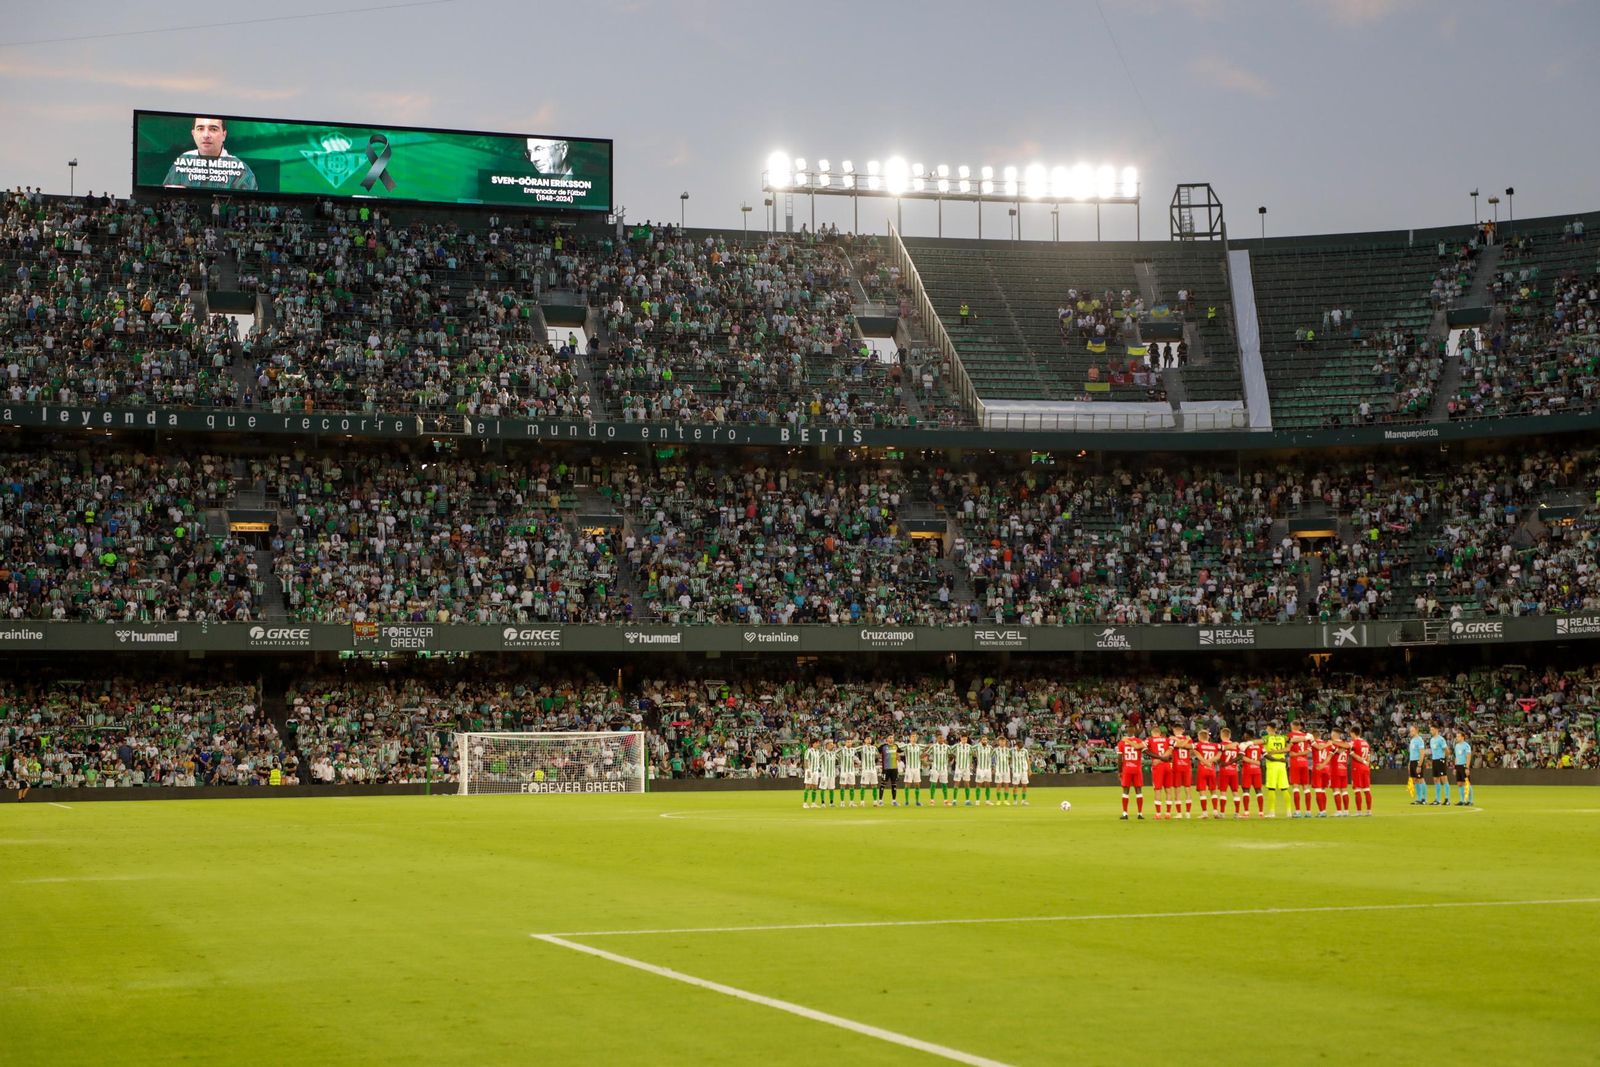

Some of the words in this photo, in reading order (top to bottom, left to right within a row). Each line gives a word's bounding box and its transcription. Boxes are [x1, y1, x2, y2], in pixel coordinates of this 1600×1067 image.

[174, 158, 207, 167] JAVIER
[208, 158, 245, 169] MÉRIDA
[175, 166, 208, 174] Periodista
[209, 168, 241, 176] Deportivo
[491, 176, 549, 187] SVEN-GÖRAN
[550, 179, 592, 189] ERIKSSON
[523, 187, 557, 195] Entrenador
[567, 189, 586, 197] Fútbol
[42, 407, 178, 425] leyenda
[206, 414, 256, 429] que
[284, 416, 403, 432] recorre
[477, 420, 500, 434] el
[527, 423, 616, 438] mundo
[781, 427, 862, 442] BETIS
[1384, 428, 1439, 439] Manquepierda
[1569, 616, 1600, 626] REALE
[382, 626, 434, 638] FOREVER
[1465, 622, 1503, 633] GREE
[1569, 625, 1600, 634] SEGUROS
[131, 630, 178, 642] hummel
[266, 628, 310, 639] GREE
[519, 629, 561, 640] GREE
[639, 632, 681, 643] hummel
[757, 632, 799, 642] trainline
[861, 629, 914, 642] Cruzcampo
[974, 630, 1027, 640] REVEL
[1215, 629, 1255, 638] REALE
[390, 638, 425, 648] GREEN
[1124, 746, 1138, 761] 55
[1157, 743, 1165, 757] 5
[521, 782, 581, 793] FOREVER
[585, 781, 626, 792] GREEN
